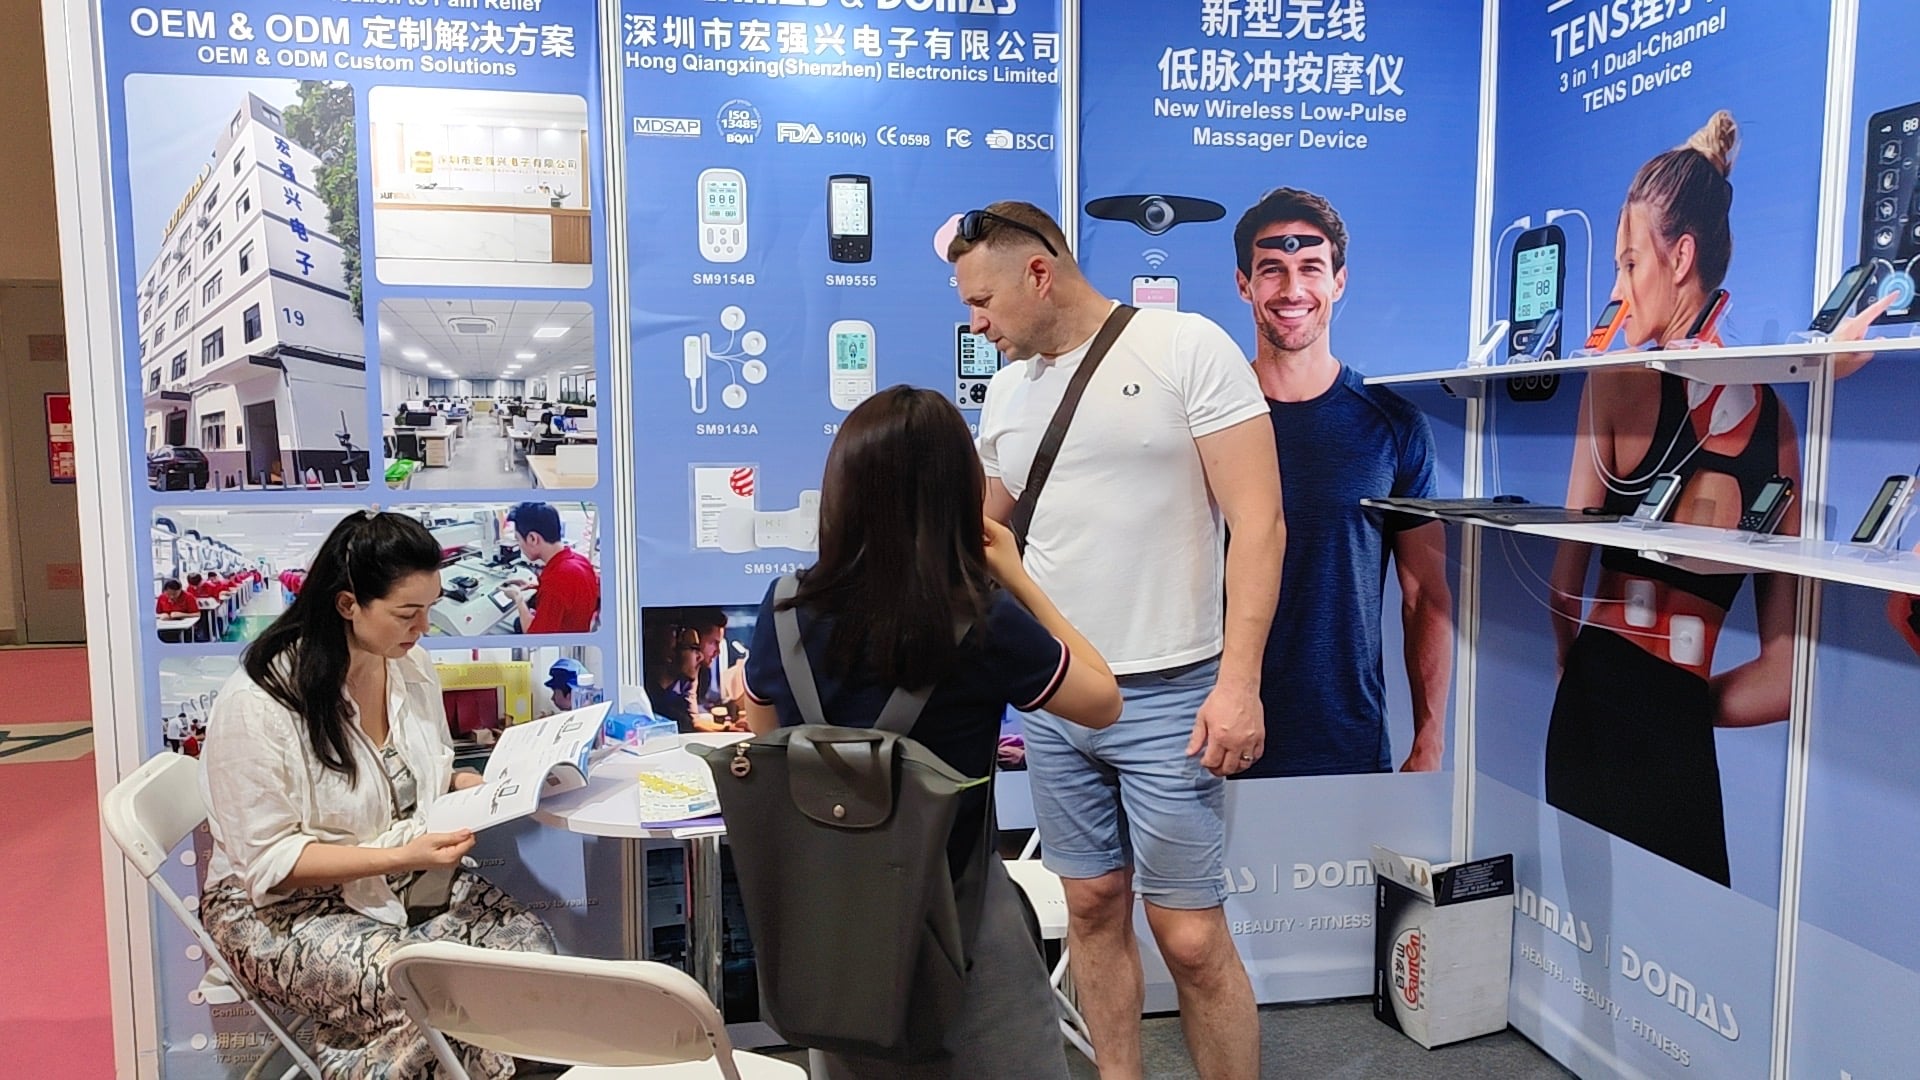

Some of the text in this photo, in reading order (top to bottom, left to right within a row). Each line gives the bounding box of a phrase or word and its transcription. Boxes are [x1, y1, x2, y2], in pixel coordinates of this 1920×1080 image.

[130, 7, 576, 58] OEM & ODM 定制解决方案
[1201, 0, 1367, 41] 新型无线
[624, 13, 1060, 63] 深圳市宏强兴电子有限公司
[1559, 7, 1726, 92] 3 in 1 Dual-Channel
[197, 46, 517, 76] OEM & ODM Custom Solutions
[626, 52, 1059, 83] Hong Qiangxing(Shenzhen) Electronics Limited
[1157, 47, 1405, 95] 低脉冲按摩仪
[1583, 60, 1692, 112] TENS Device
[728, 110, 750, 120] ISO
[1154, 98, 1407, 122] New Wireless Low-Pulse
[635, 119, 699, 134] MDSAP
[721, 119, 758, 129] 13485
[776, 122, 867, 147] FDA 510(k)
[900, 134, 931, 147] 0598
[1016, 134, 1054, 150] BSCI
[1192, 127, 1368, 151] Massager Device
[693, 273, 756, 285] SM9154B
[825, 274, 877, 286] SM9555
[282, 308, 305, 326] 19
[696, 424, 758, 435] SM9143A
[1293, 860, 1376, 889] DOM
[1232, 914, 1372, 934] BEAUTY FITNESS
[1621, 944, 1740, 1041] DOMAS
[1520, 943, 1691, 1067] HEALTH BEAUTY FITNESS
